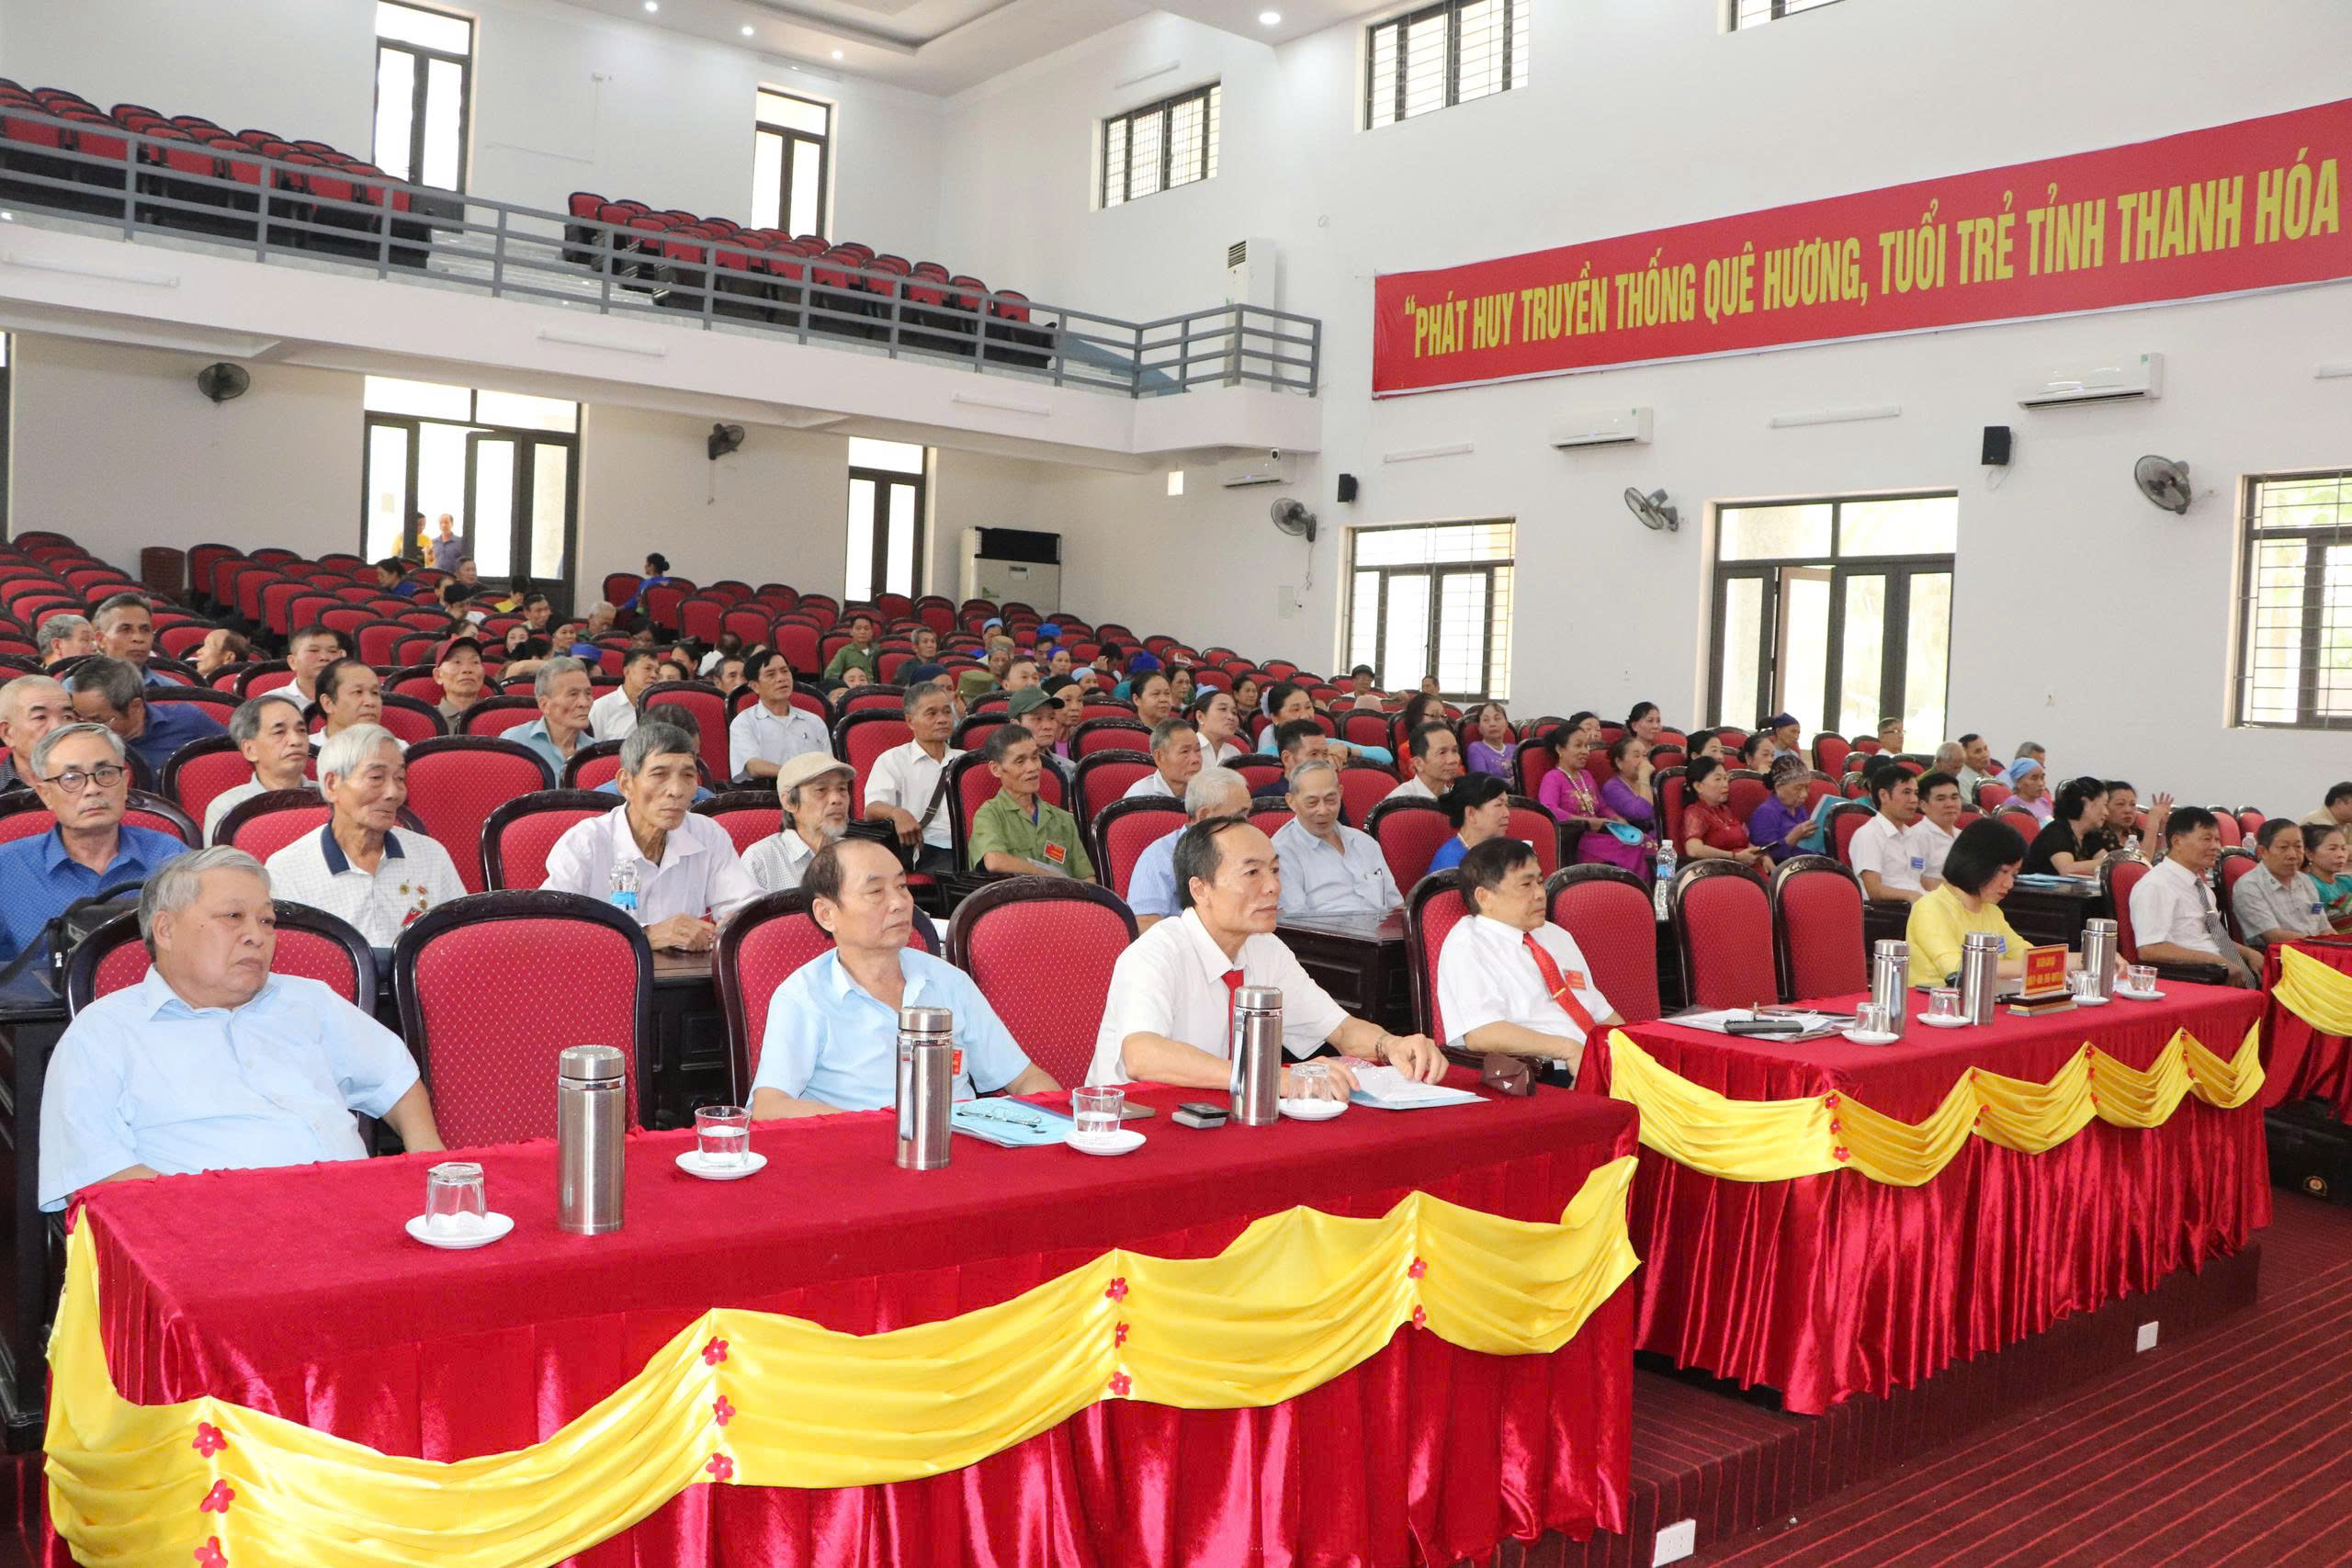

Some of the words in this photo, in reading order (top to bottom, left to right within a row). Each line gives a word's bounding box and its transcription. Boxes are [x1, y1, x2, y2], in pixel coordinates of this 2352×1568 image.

[1405, 290, 1467, 358] “PHÁT
[1473, 292, 1514, 349] HUY
[1521, 262, 1608, 342] TRUYỀN
[1614, 247, 1696, 330] THỐNG
[1705, 242, 1755, 324] QUÊ
[1763, 236, 1869, 309] HƯƠNG,
[1879, 198, 1947, 295] TUỔI
[1957, 190, 2016, 285] TRẺ
[2026, 183, 2106, 276] TỈNH
[2117, 176, 2244, 264] THANH
[2255, 147, 2340, 244] HÓA
